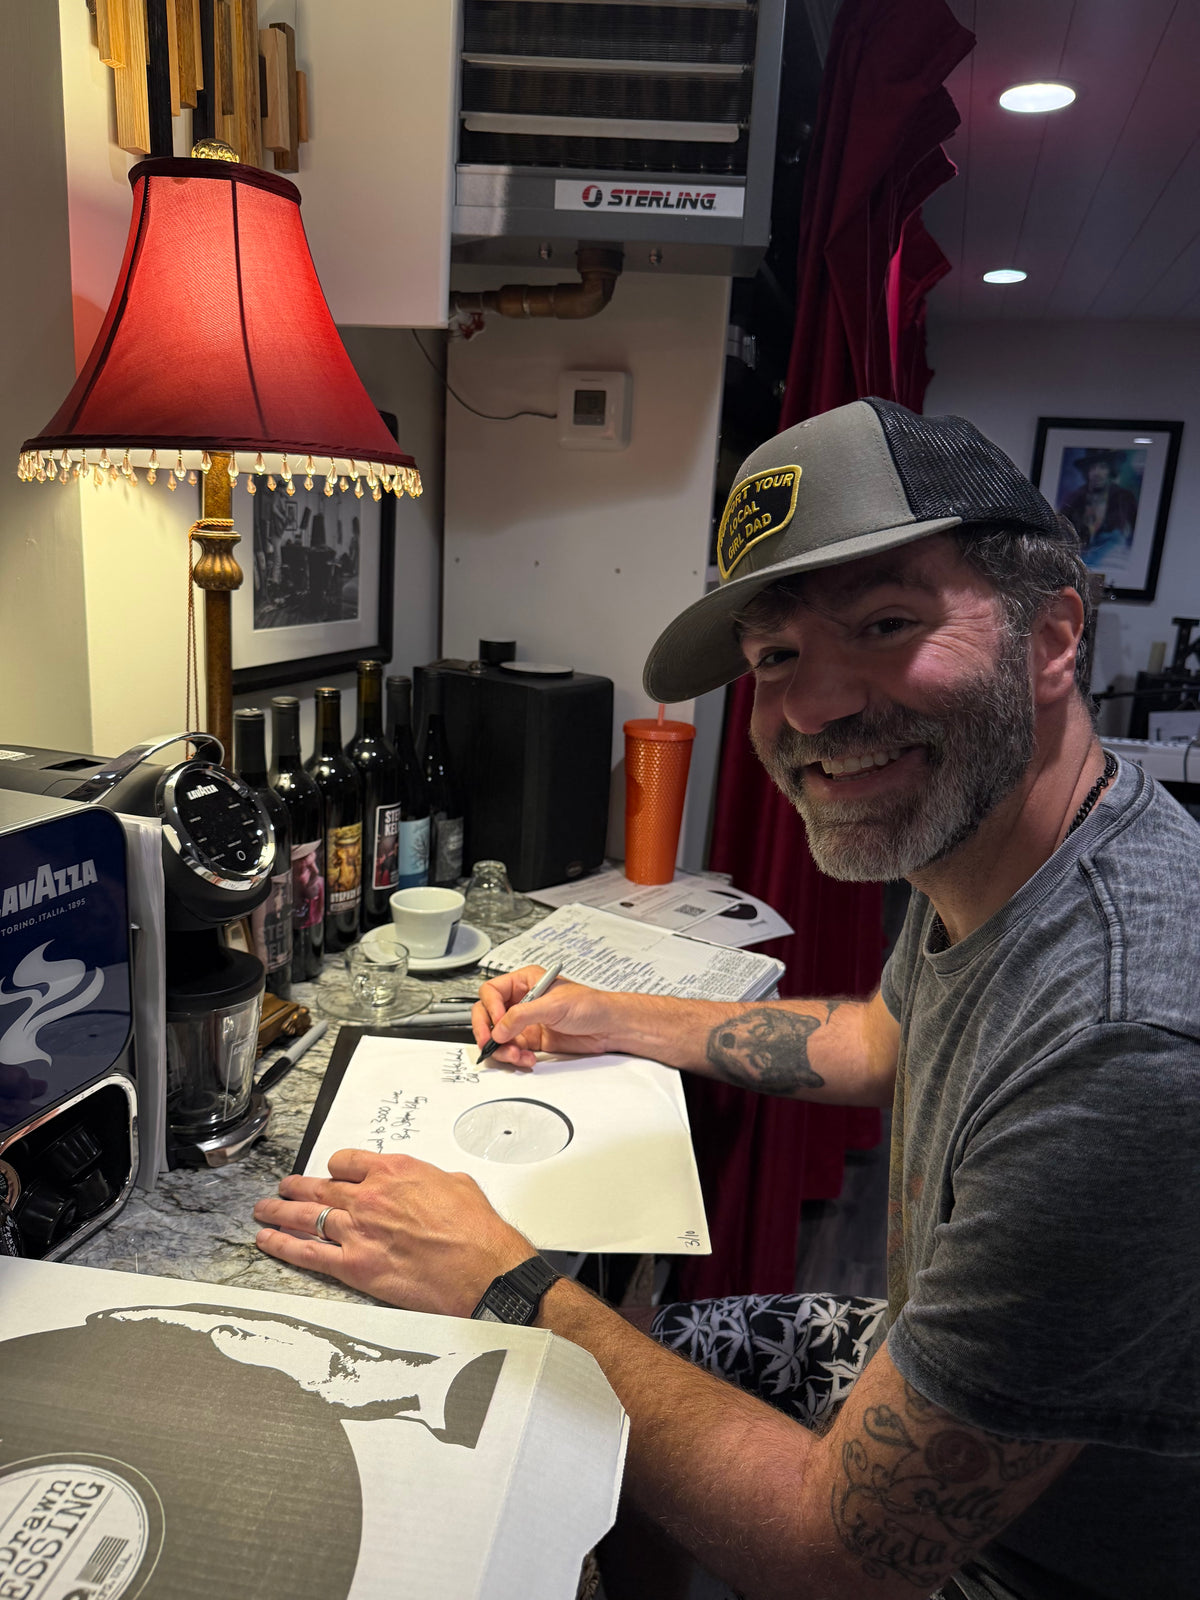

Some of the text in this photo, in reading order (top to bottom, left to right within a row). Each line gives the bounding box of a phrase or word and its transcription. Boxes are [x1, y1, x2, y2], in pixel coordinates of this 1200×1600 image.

[607, 188, 716, 210] STERLING
[755, 473, 794, 493] YOUR
[729, 501, 760, 536] LOCAL
[728, 513, 772, 560] GIRL DAD
[186, 784, 219, 800] LAVAZZA
[0, 859, 98, 918] AVAZZA
[370, 1106, 392, 1123] 3000
[381, 1090, 403, 1104] Live
[390, 1128, 420, 1141] By
[677, 1230, 700, 1248] 3/10
